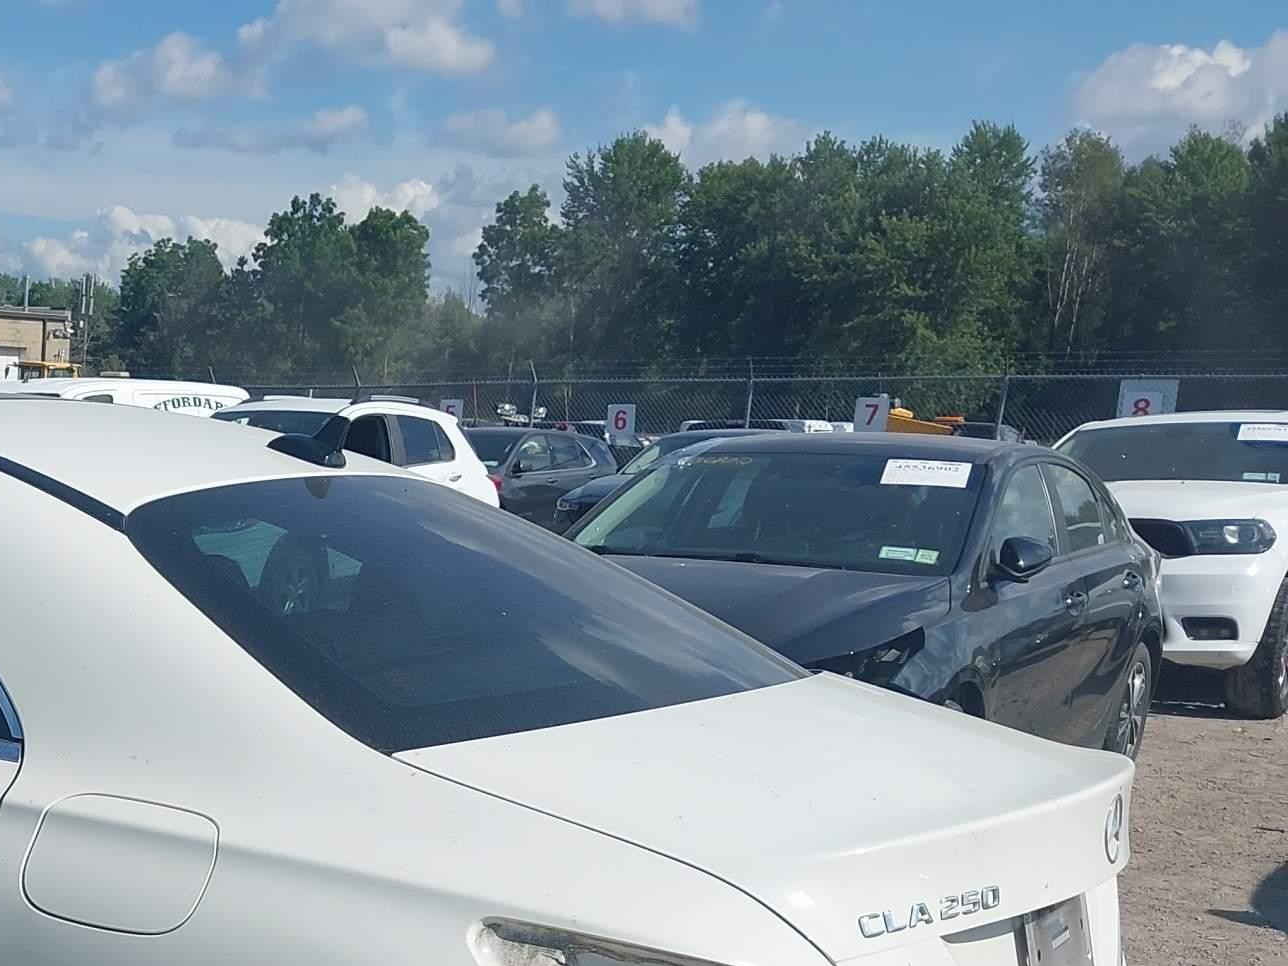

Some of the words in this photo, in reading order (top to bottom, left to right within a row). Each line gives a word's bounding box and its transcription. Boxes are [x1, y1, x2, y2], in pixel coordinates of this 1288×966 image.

[865, 404, 879, 425] 7
[1132, 398, 1150, 416] 8
[615, 410, 627, 430] 6
[858, 902, 934, 938] CLA
[939, 885, 1000, 920] 250
